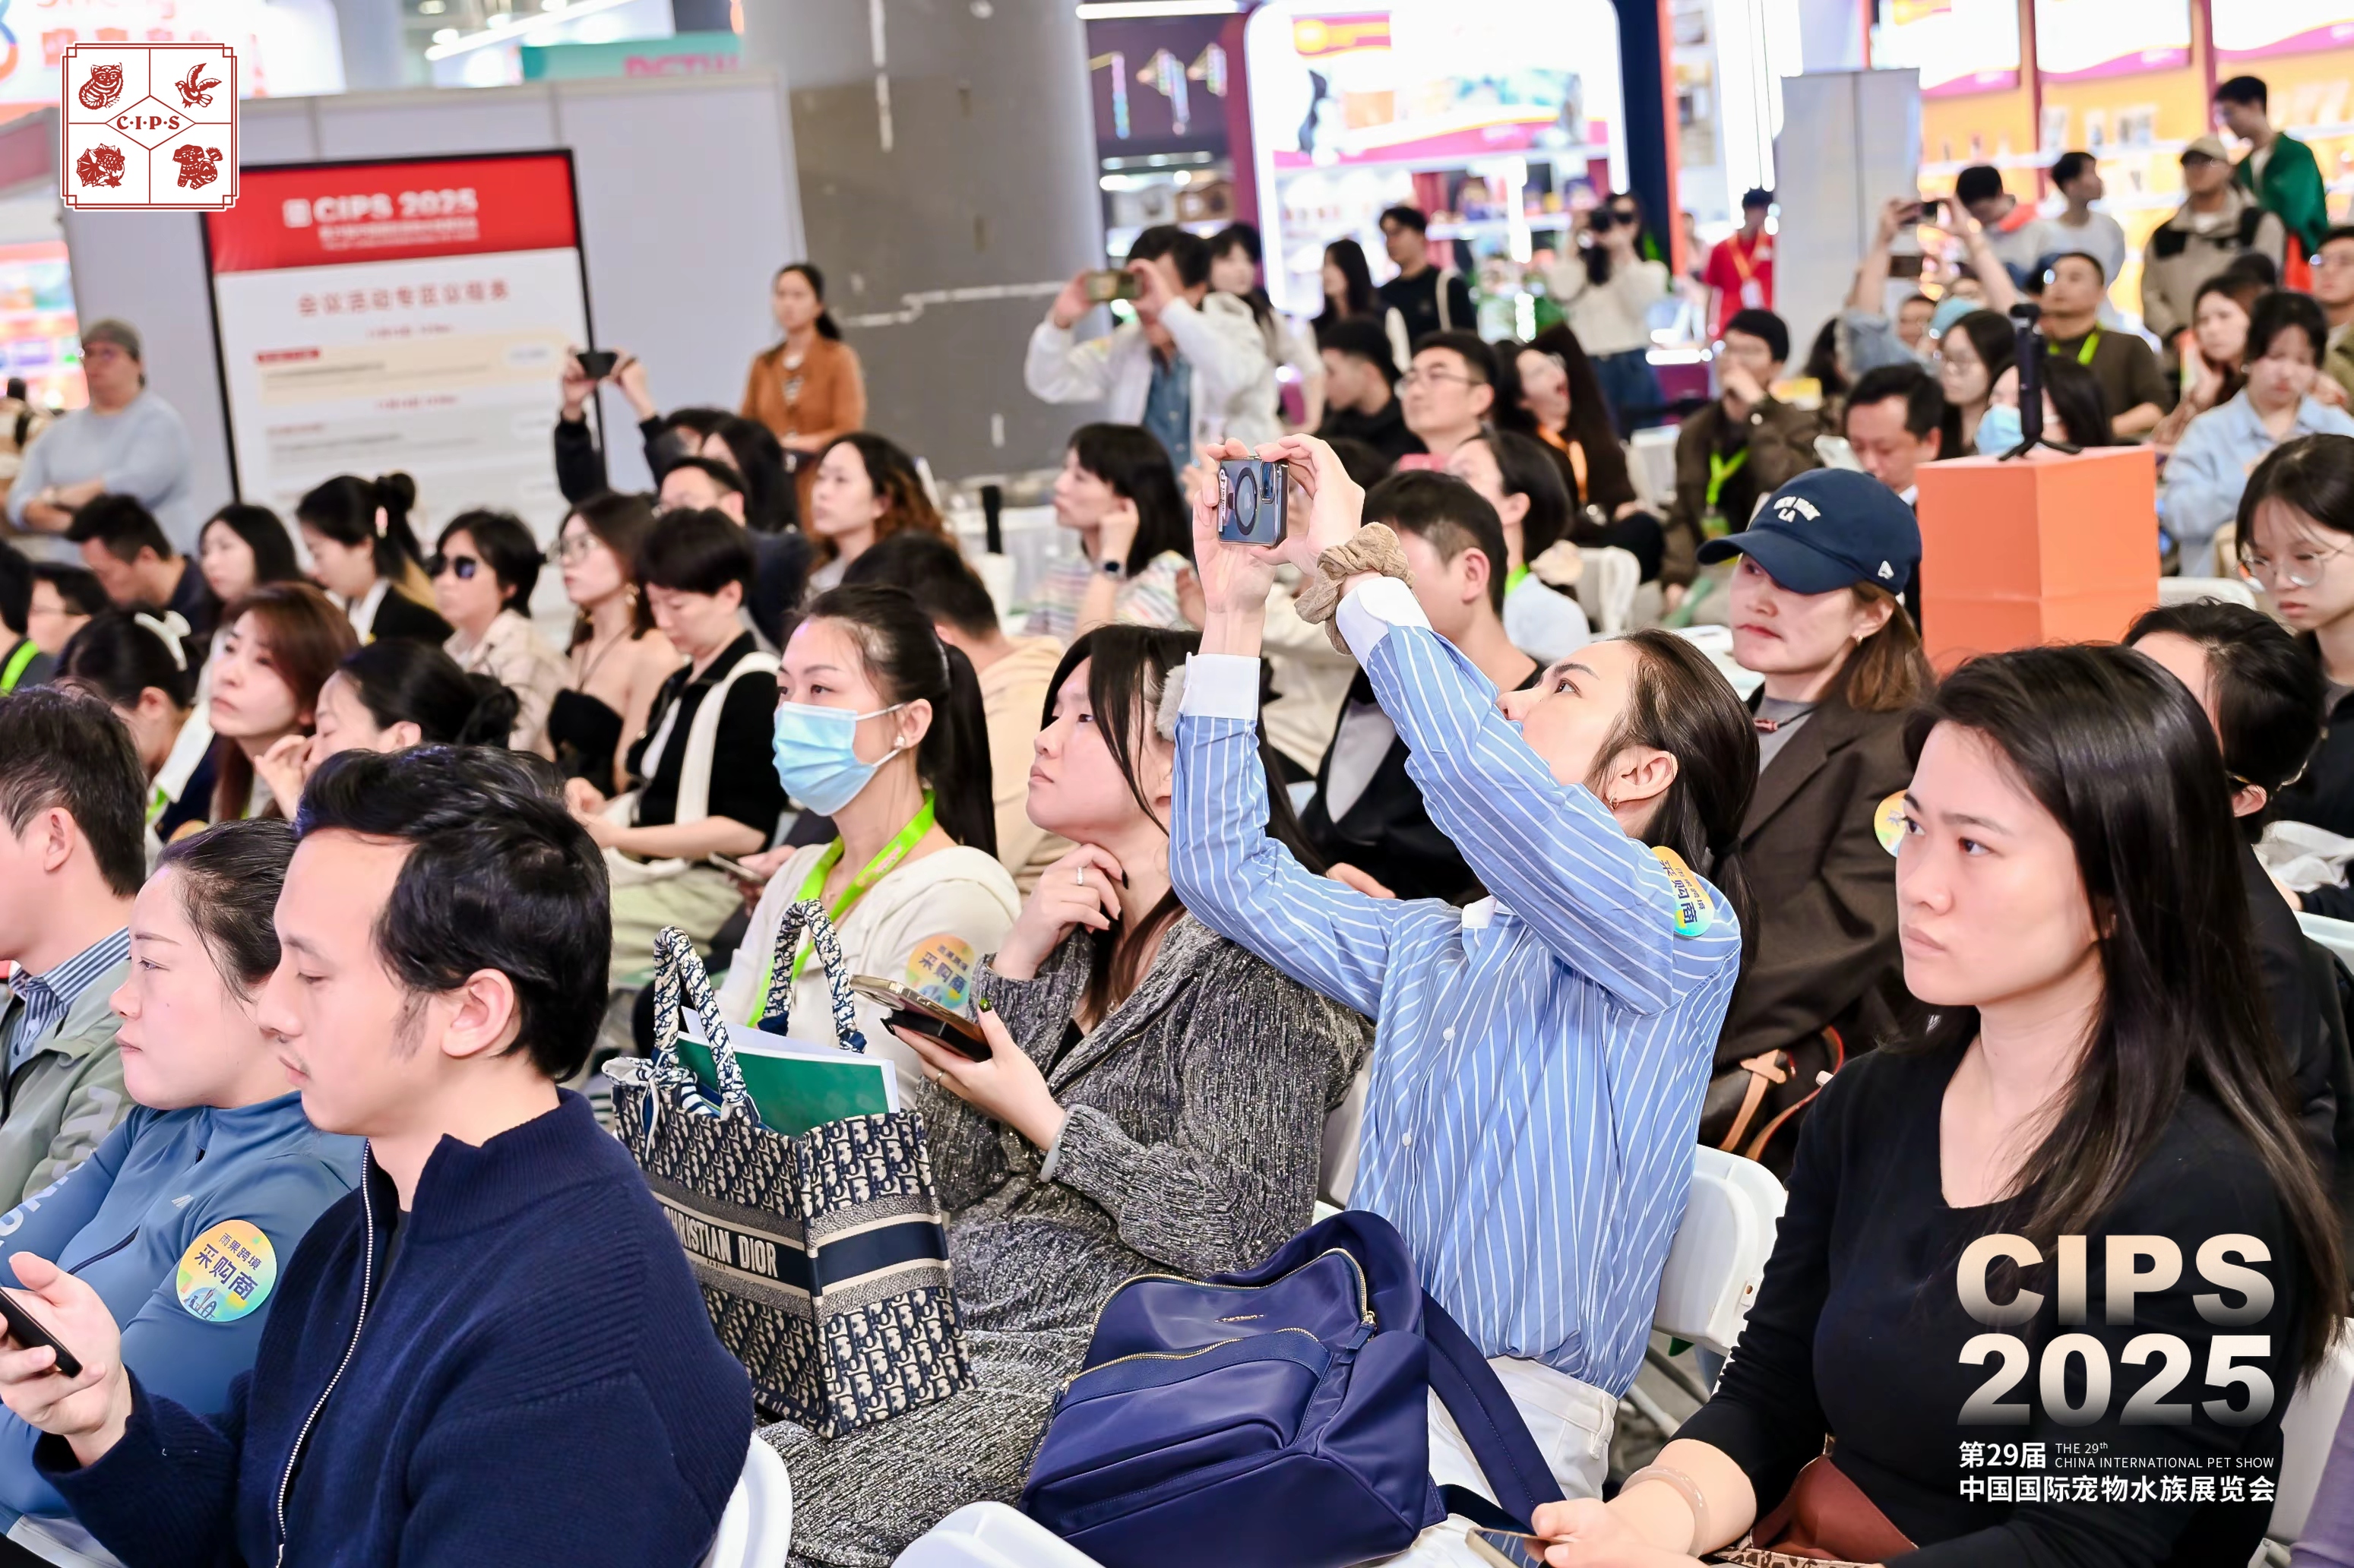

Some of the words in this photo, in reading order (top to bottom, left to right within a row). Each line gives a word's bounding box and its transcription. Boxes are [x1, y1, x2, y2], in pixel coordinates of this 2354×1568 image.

[313, 193, 394, 223] CIPS
[397, 188, 478, 218] 2025
[1778, 507, 1796, 523] LA
[1660, 859, 1697, 924] 采购商
[918, 950, 967, 994] 采购商
[194, 1243, 258, 1301] 采购商
[218, 1232, 262, 1271] 雨果跨境
[738, 1234, 778, 1278] DIOR
